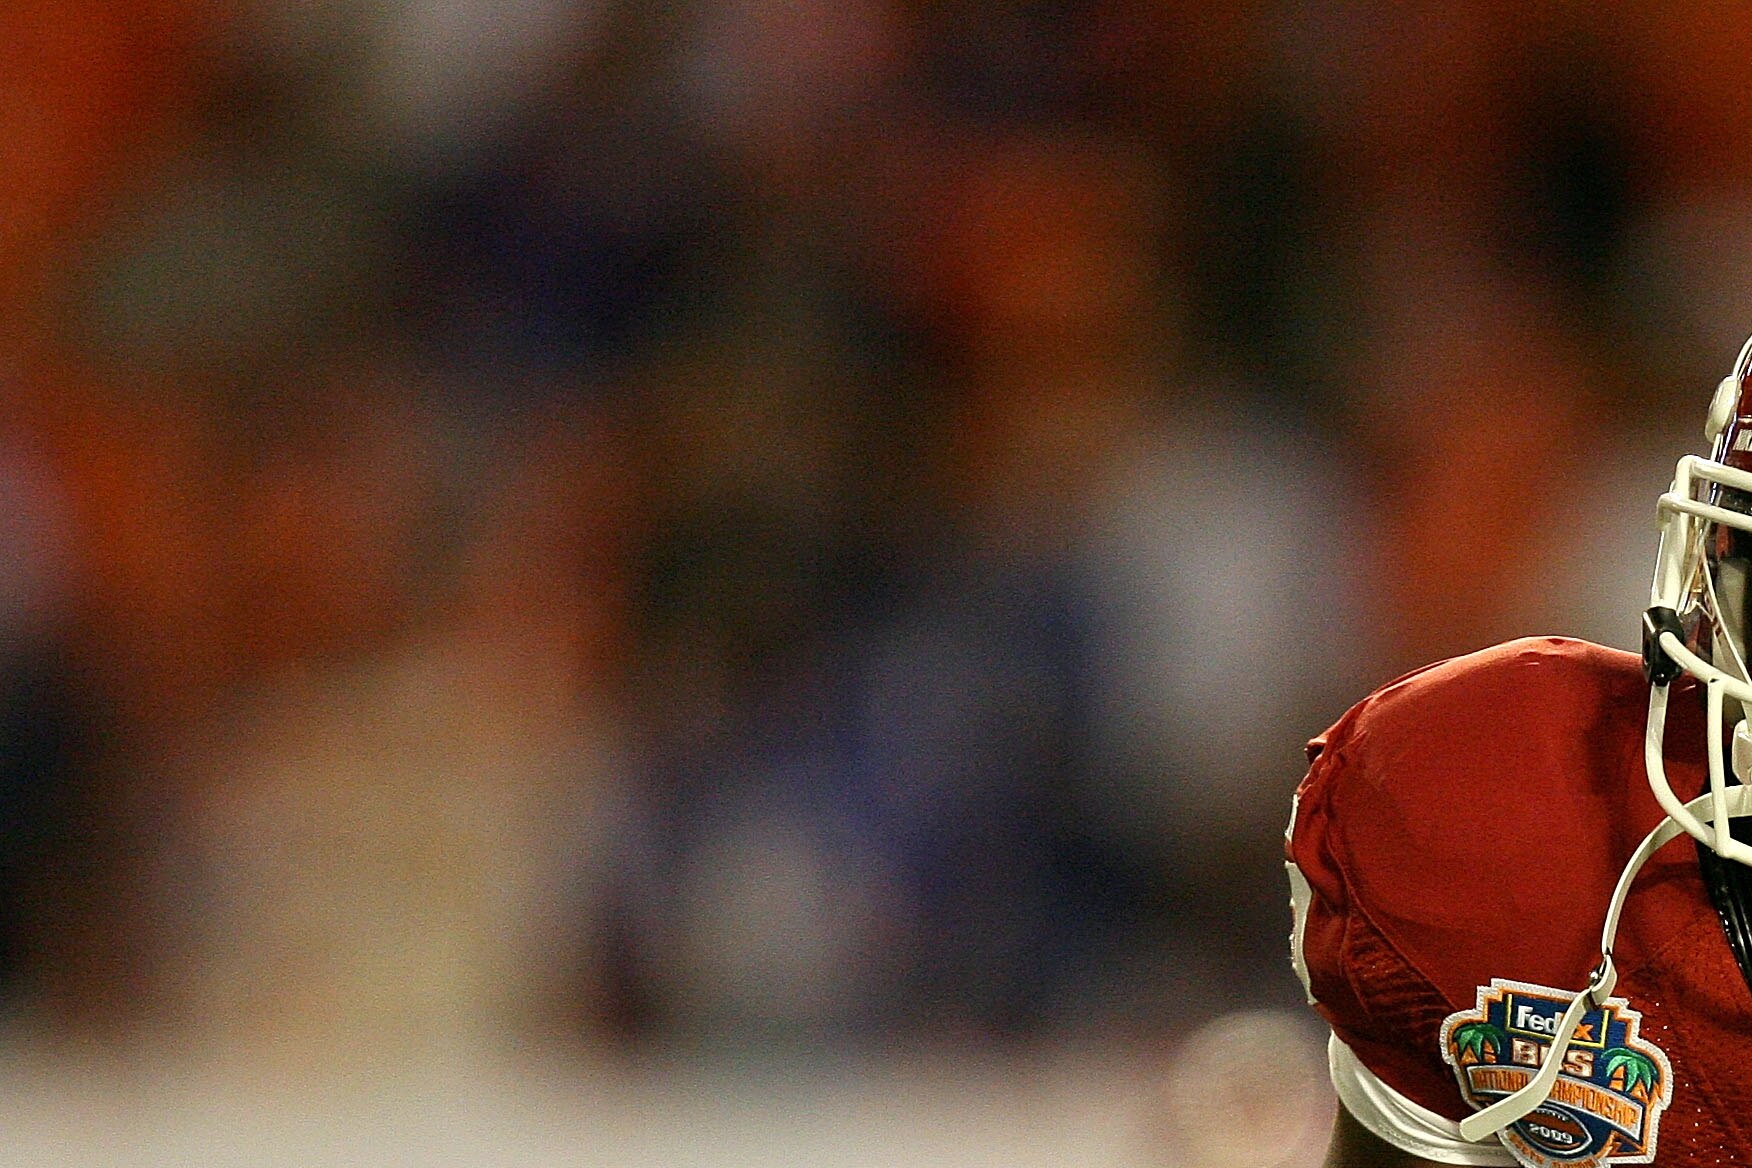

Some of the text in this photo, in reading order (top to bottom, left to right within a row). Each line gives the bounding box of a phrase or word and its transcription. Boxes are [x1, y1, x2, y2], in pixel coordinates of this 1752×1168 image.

[1516, 1005, 1594, 1042] Fedx
[1549, 1078, 1638, 1127] AMPIONSHIP
[1528, 1123, 1573, 1144] 2009
